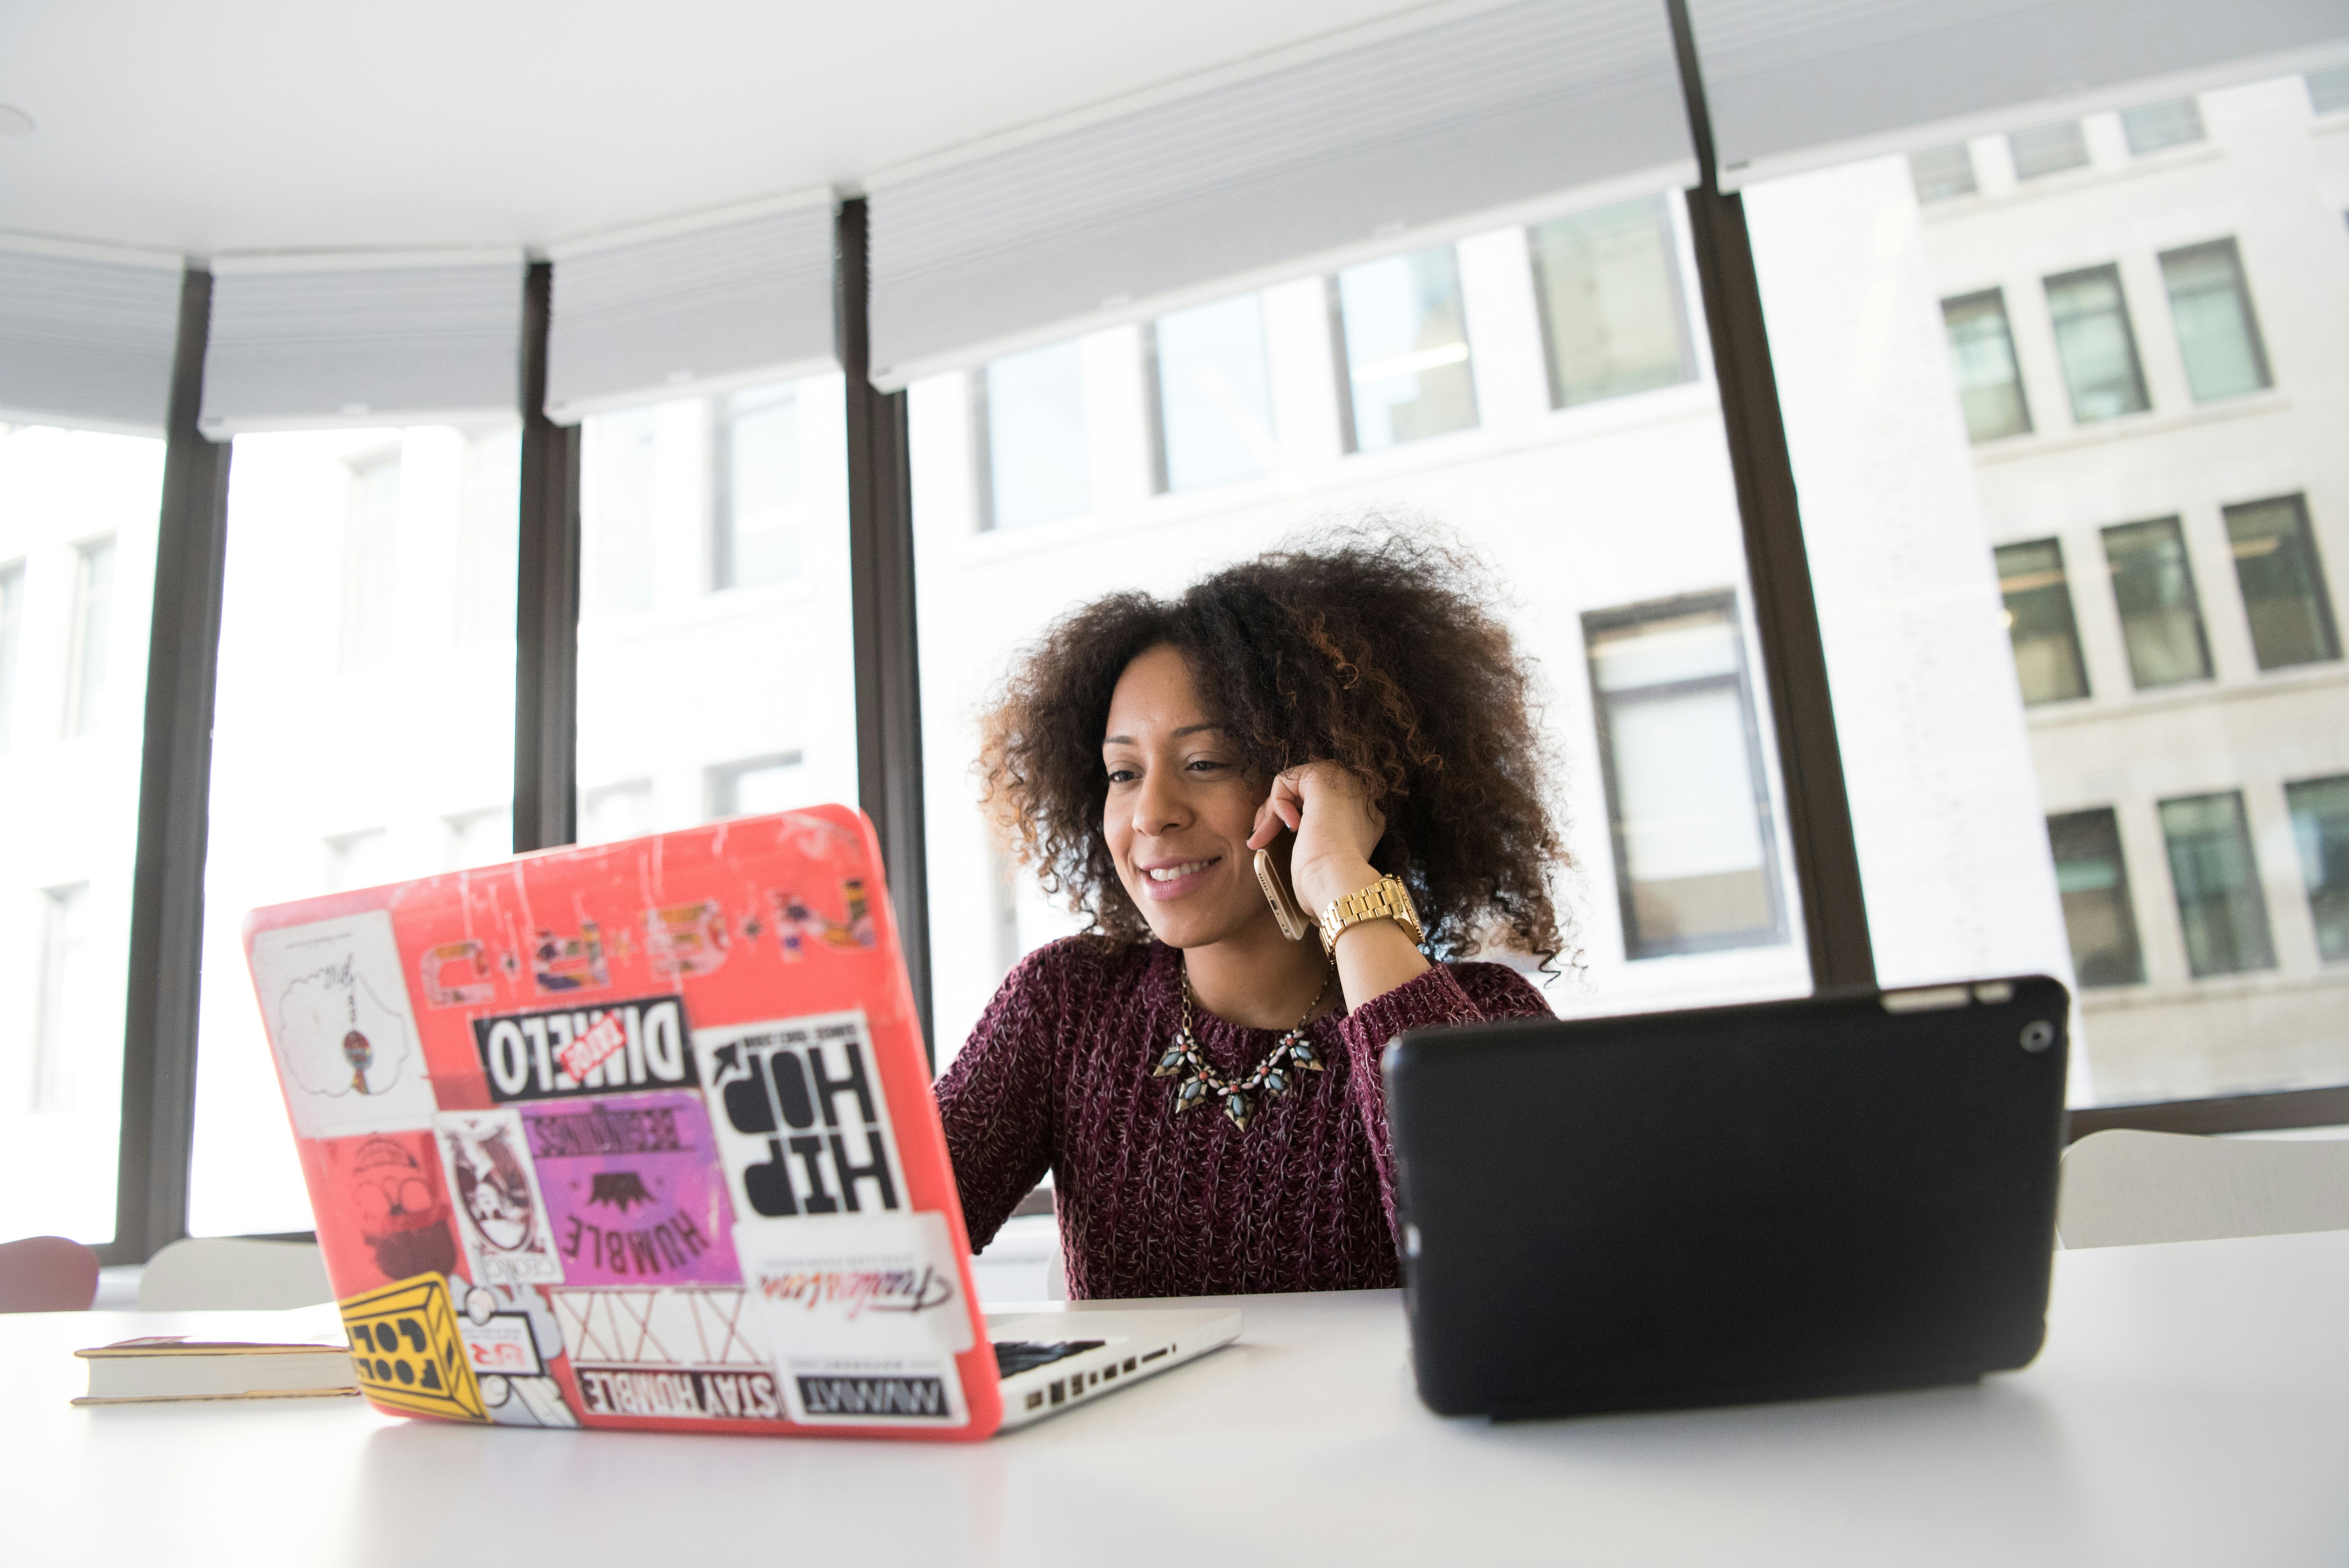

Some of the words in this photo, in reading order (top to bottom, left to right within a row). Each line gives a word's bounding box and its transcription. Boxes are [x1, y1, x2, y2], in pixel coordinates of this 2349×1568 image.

[488, 1002, 686, 1095] DIMELO
[724, 1043, 876, 1134] HOP
[745, 1132, 898, 1217] HIP
[563, 1210, 709, 1275] HUMBLE
[586, 1370, 695, 1414] HUMBLE
[702, 1372, 779, 1417] STAY
